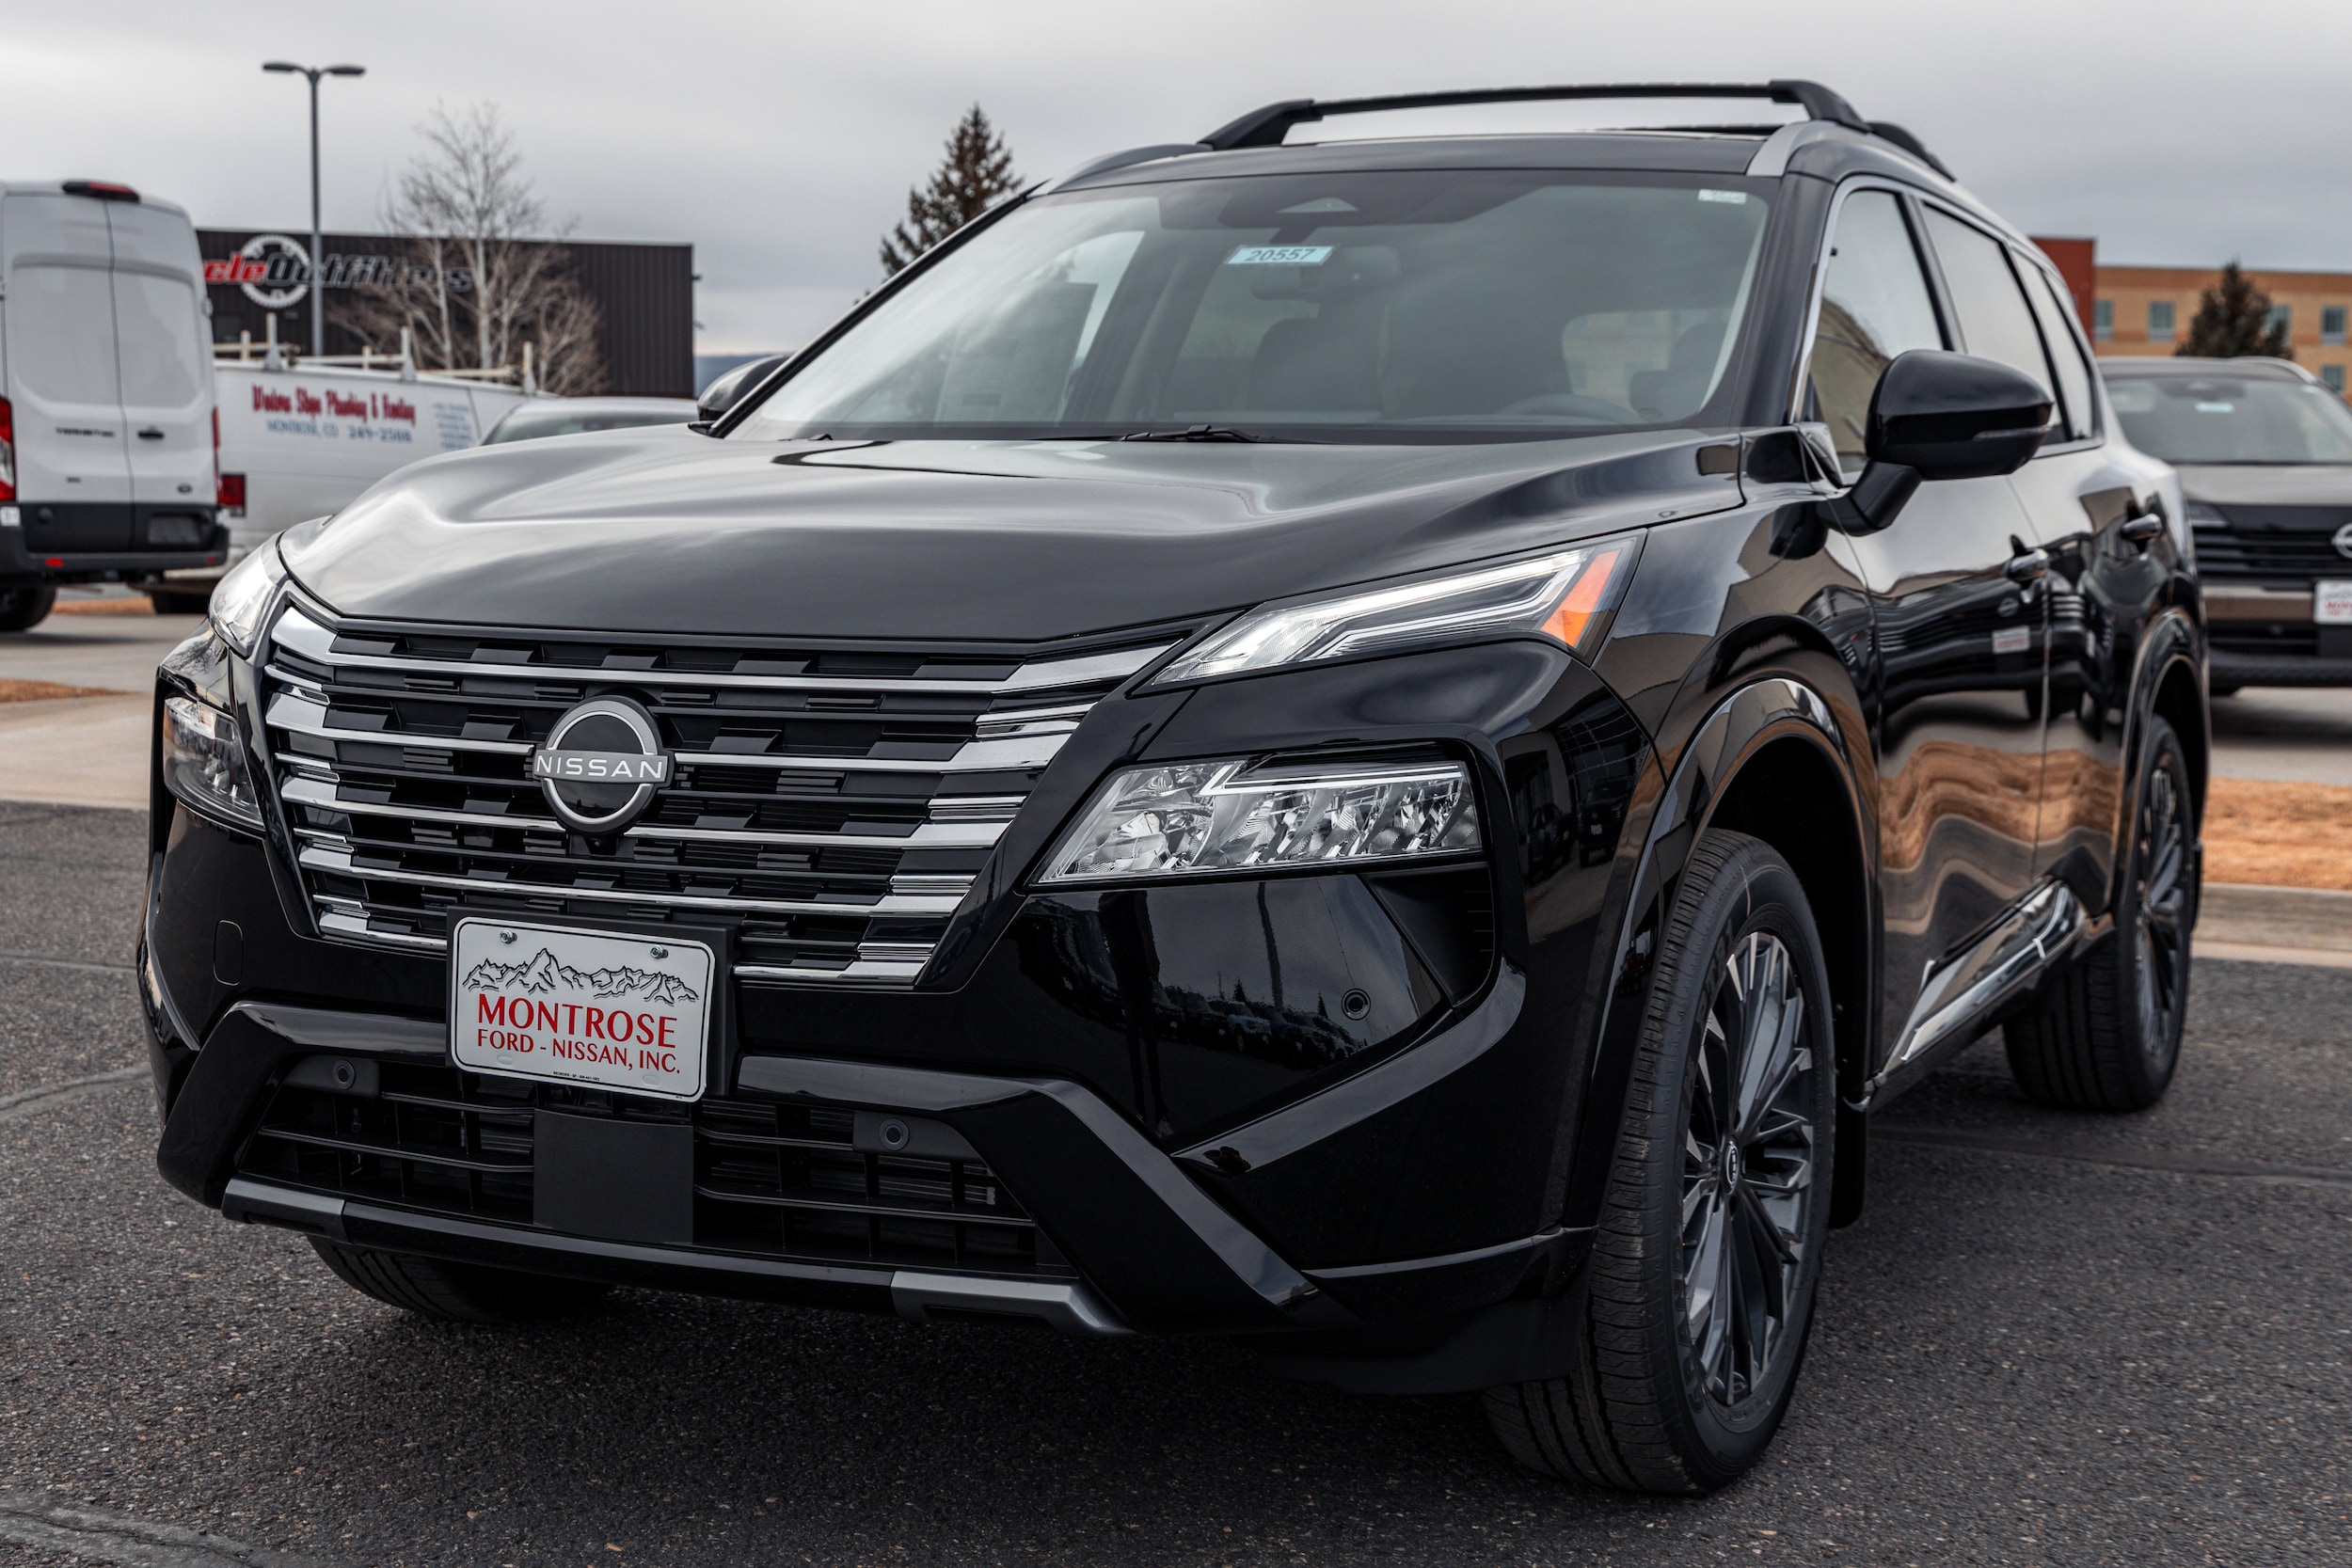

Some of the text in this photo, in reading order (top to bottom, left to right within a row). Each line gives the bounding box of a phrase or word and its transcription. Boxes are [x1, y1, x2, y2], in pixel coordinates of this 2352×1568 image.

[1244, 247, 1316, 262] 20557
[535, 754, 663, 779] NISSAN
[477, 993, 677, 1049] MONTROSE
[477, 1029, 533, 1053] FORD
[552, 1038, 633, 1071] NISSAN,
[639, 1050, 680, 1074] INC.
